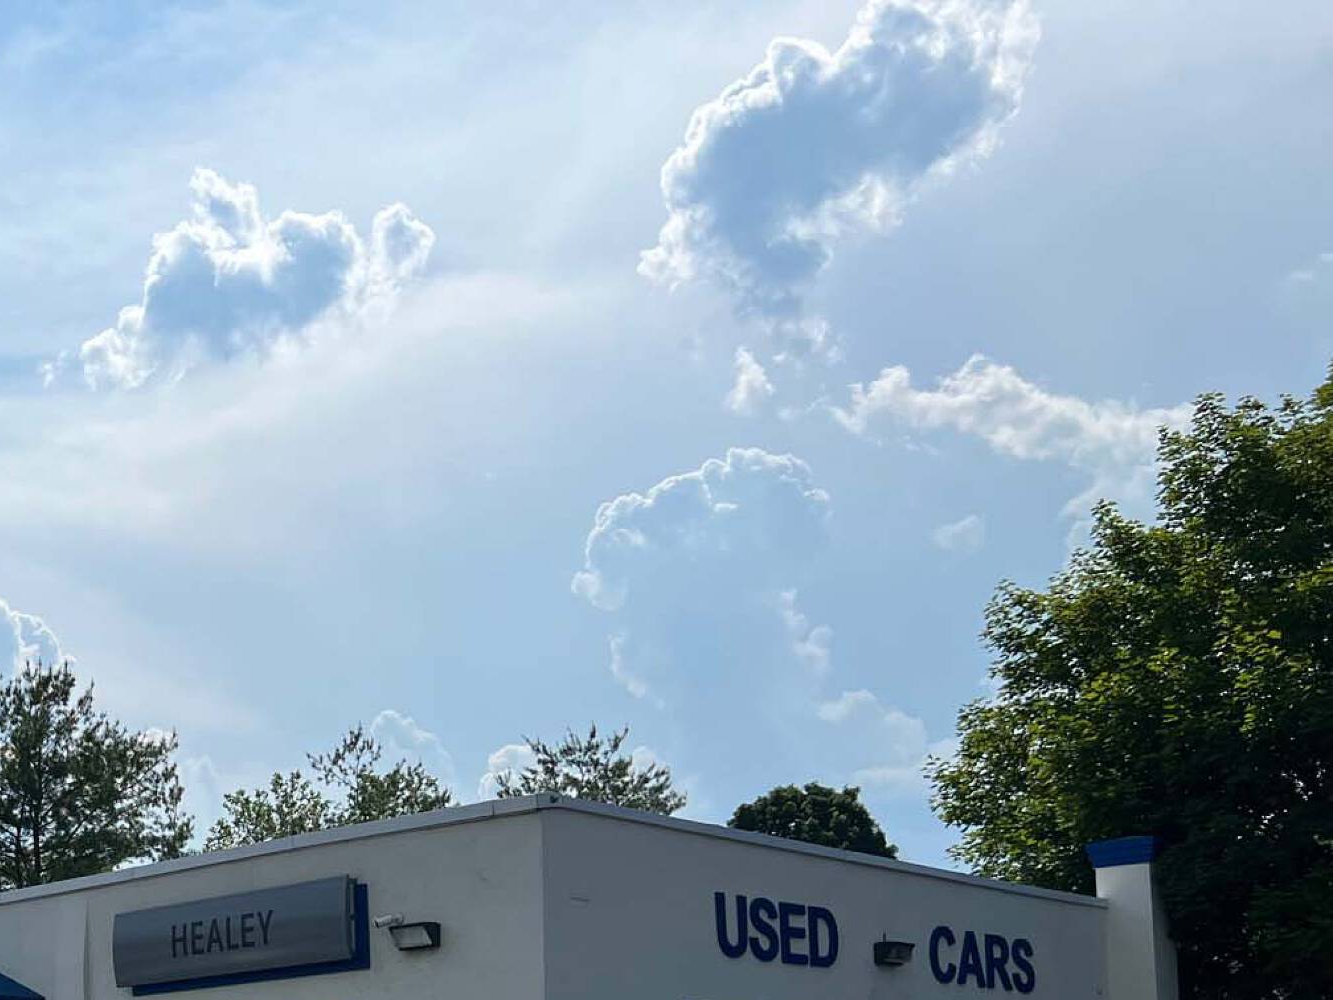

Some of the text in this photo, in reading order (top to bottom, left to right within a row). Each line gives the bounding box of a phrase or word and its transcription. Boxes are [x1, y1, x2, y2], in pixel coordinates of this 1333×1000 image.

[170, 909, 274, 958] HEALEY
[713, 891, 1036, 995] USED CARS
